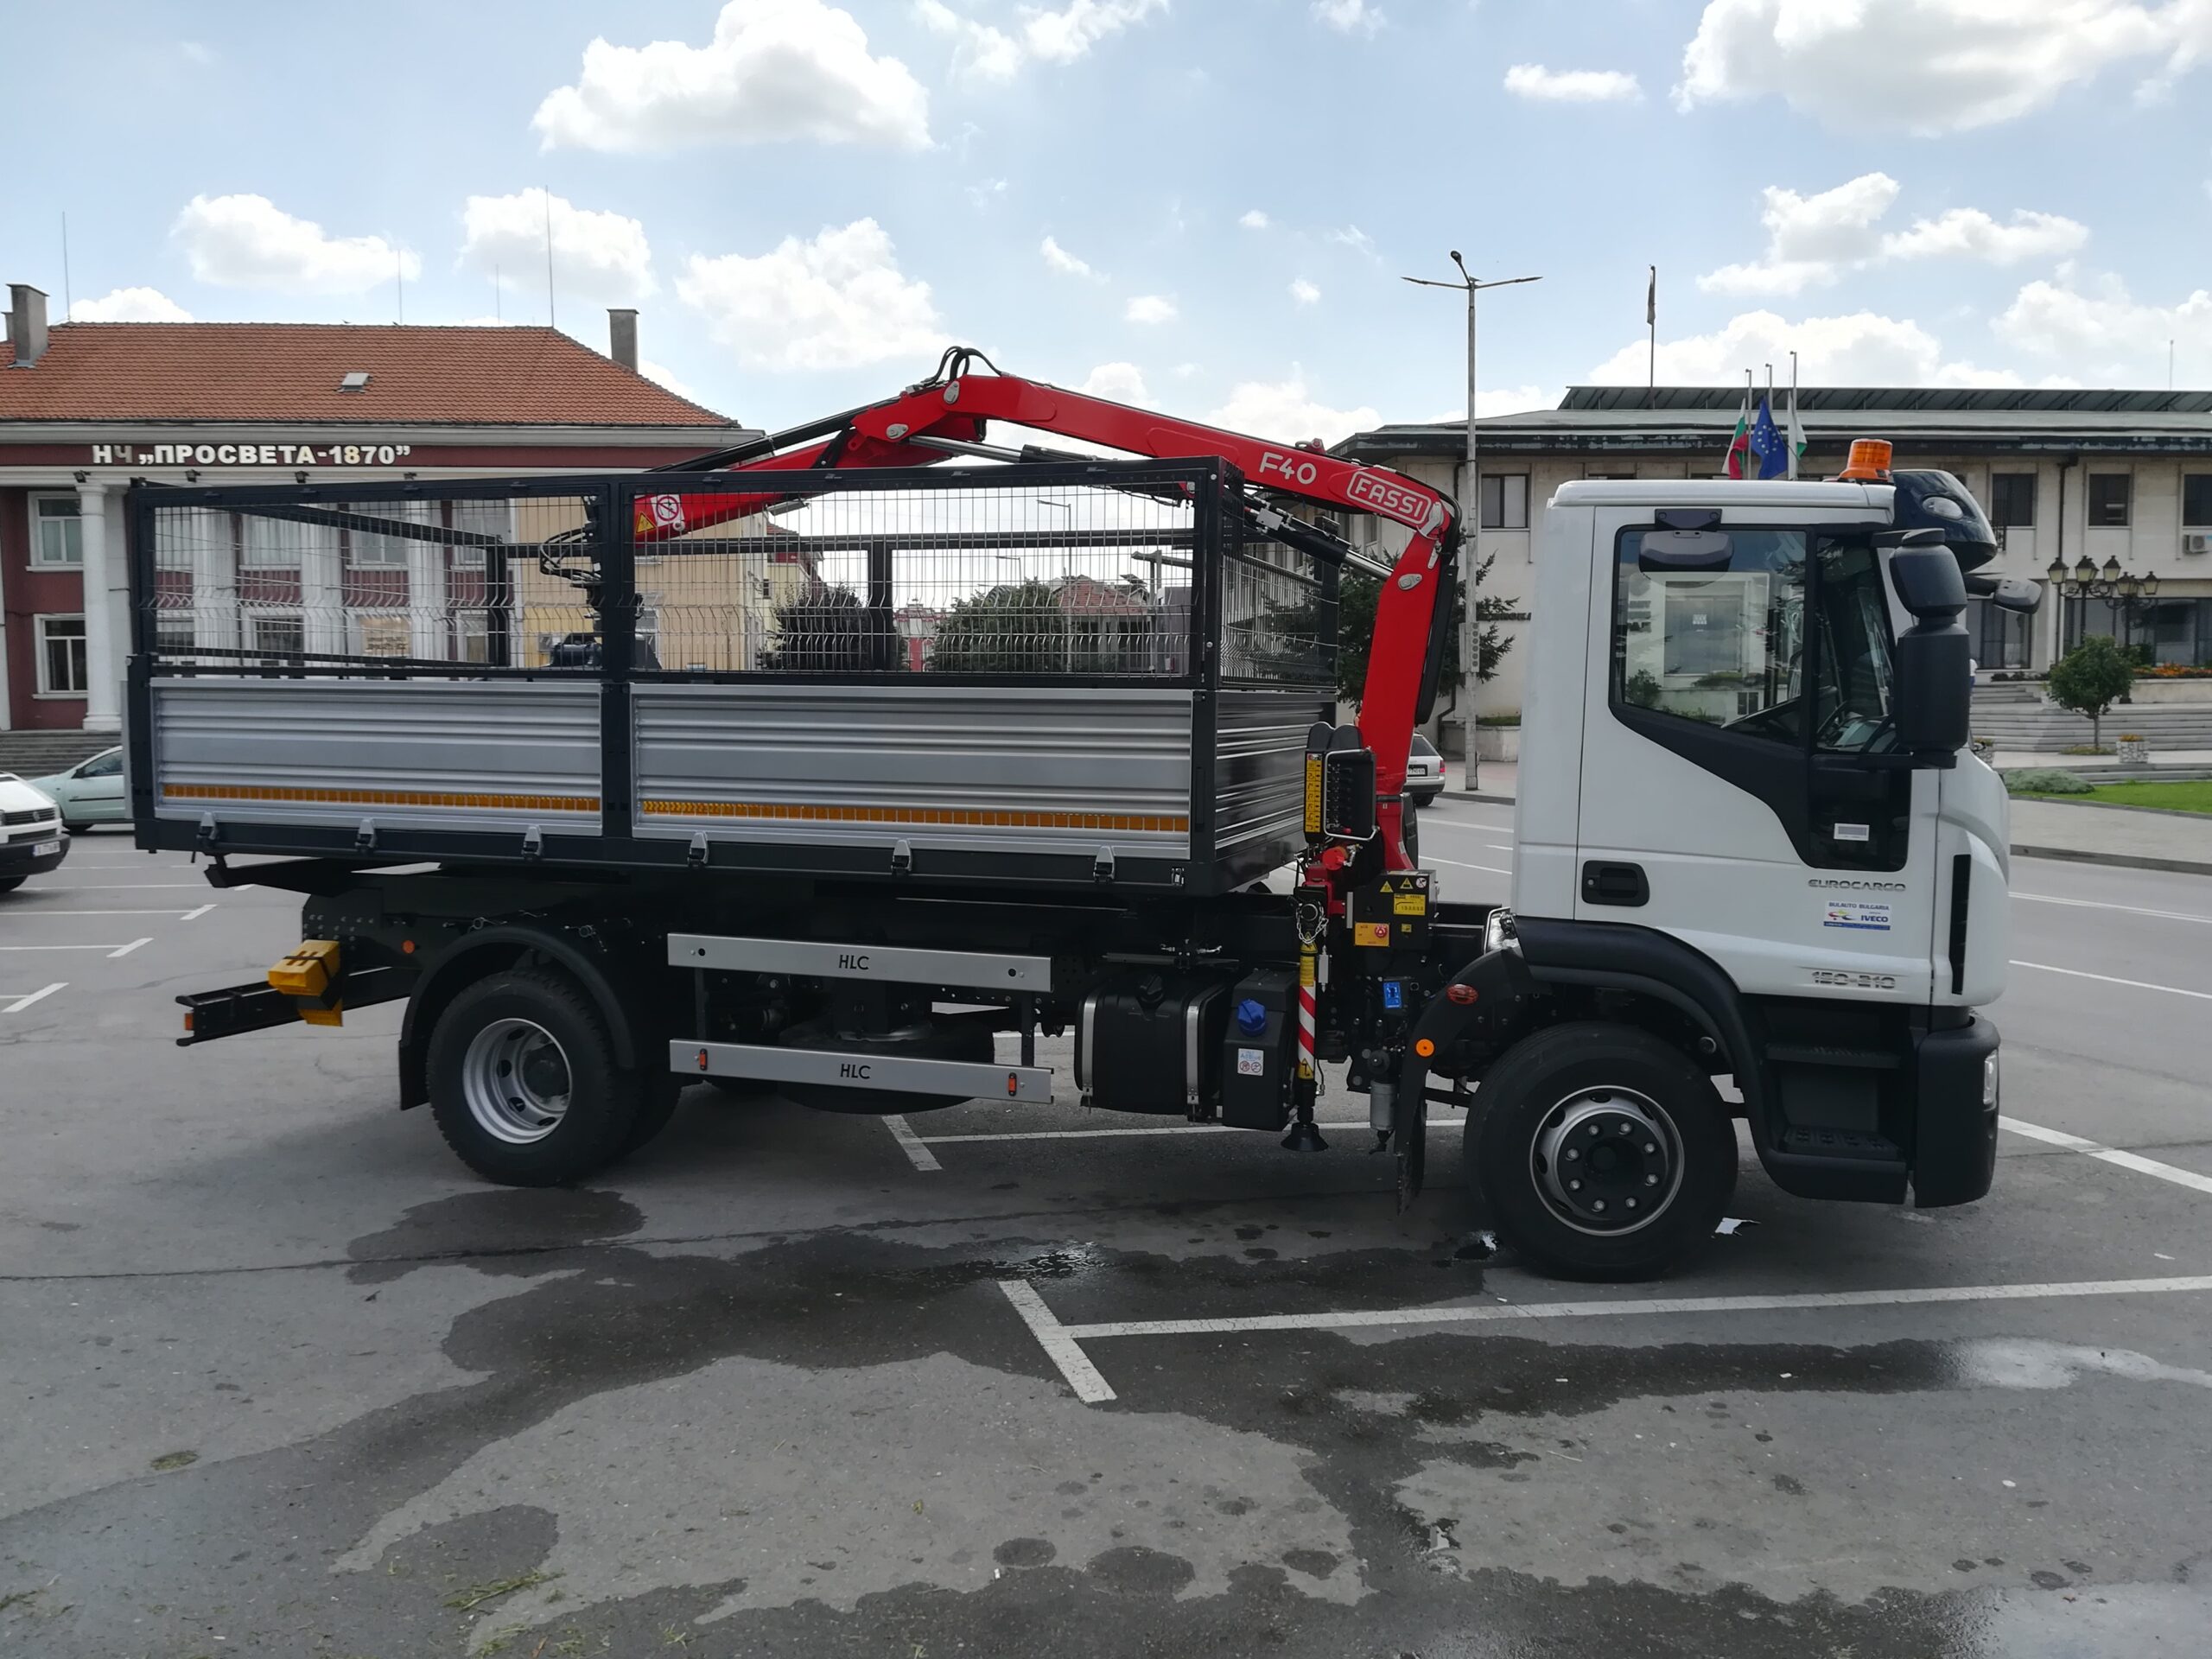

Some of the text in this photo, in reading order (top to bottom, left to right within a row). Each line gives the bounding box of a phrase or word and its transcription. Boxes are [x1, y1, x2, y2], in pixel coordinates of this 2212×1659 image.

[92, 444, 133, 464] НЧ
[1259, 451, 1317, 485] F40
[1354, 477, 1423, 518] FASSI
[1808, 879, 1906, 892] EUROCARGO
[1860, 914, 1889, 923] IVECO
[838, 954, 869, 970] HLC
[840, 1063, 872, 1079] HLC
